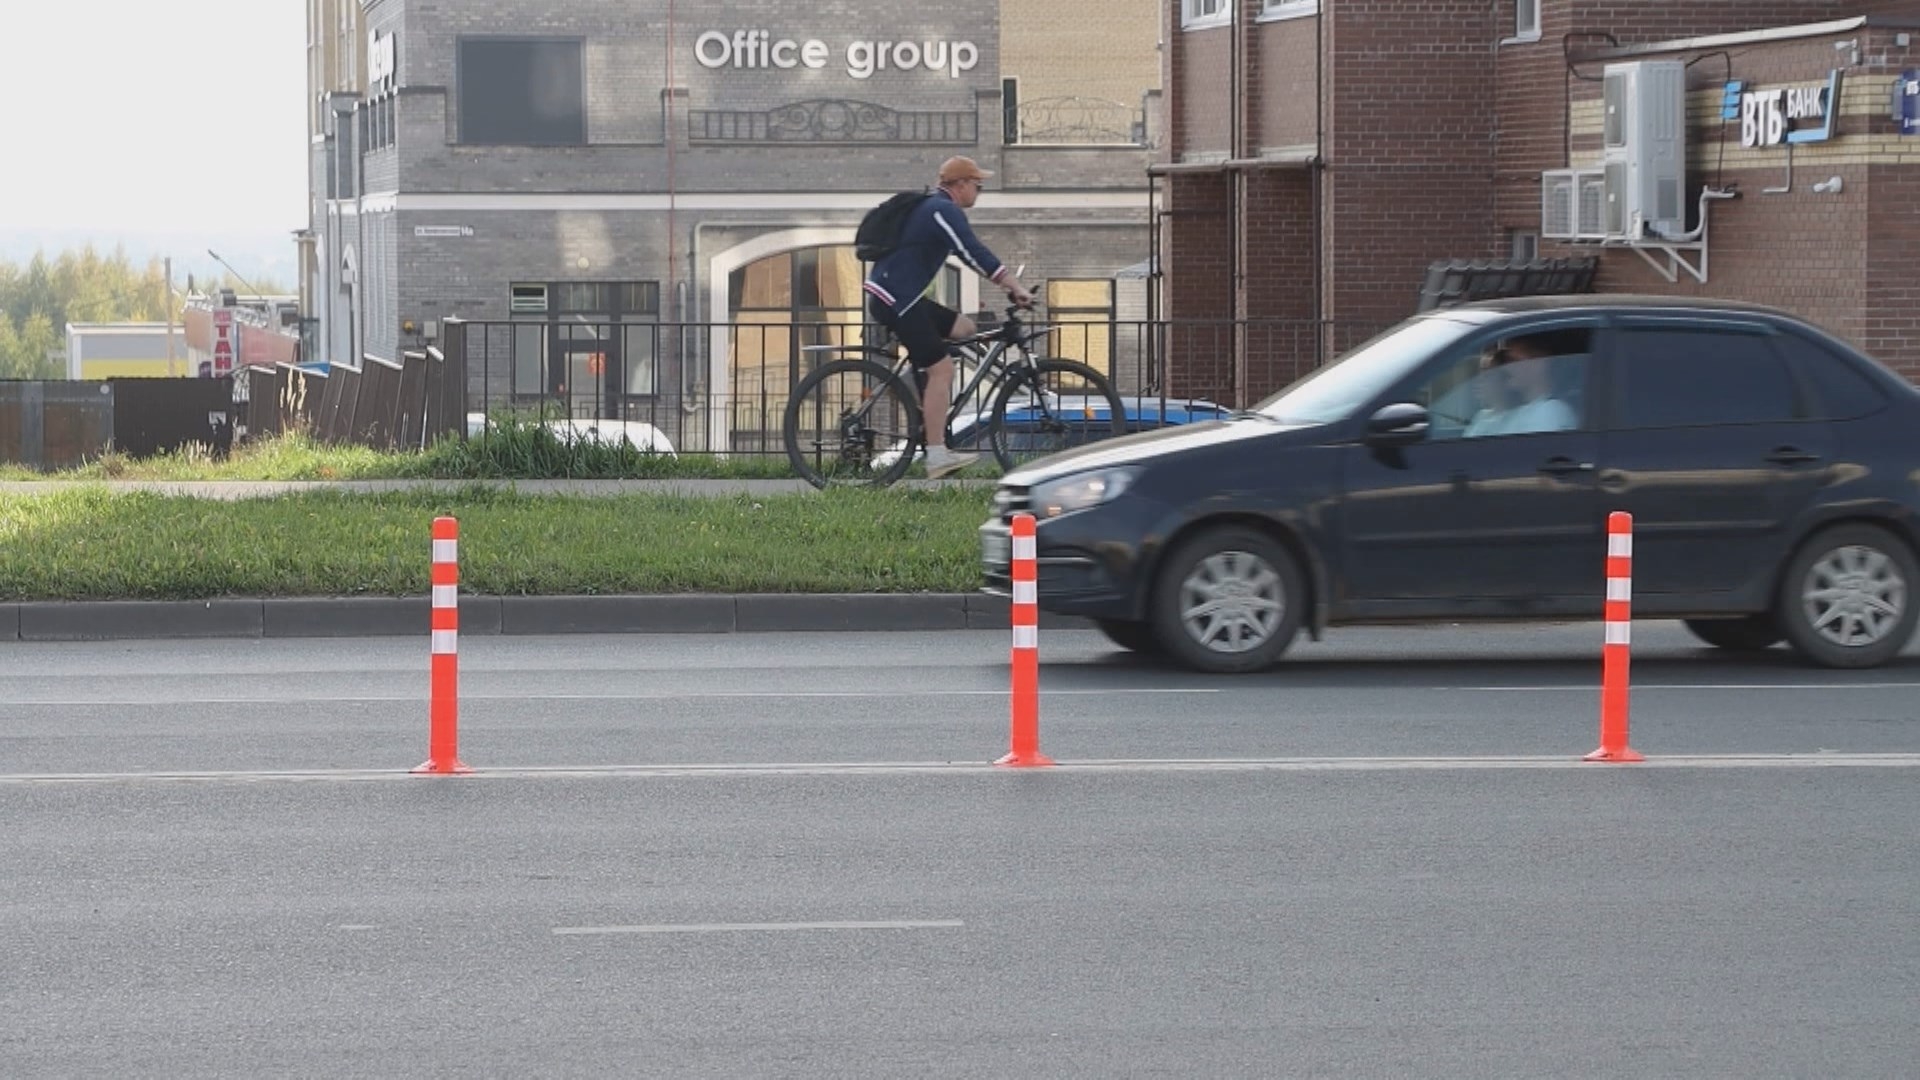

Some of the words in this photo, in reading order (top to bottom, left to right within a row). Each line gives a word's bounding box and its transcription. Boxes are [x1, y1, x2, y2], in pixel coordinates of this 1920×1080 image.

[695, 29, 829, 69] Office
[846, 40, 979, 79] group
[1742, 88, 1783, 147] ВТБ
[1786, 86, 1823, 119] БАНК
